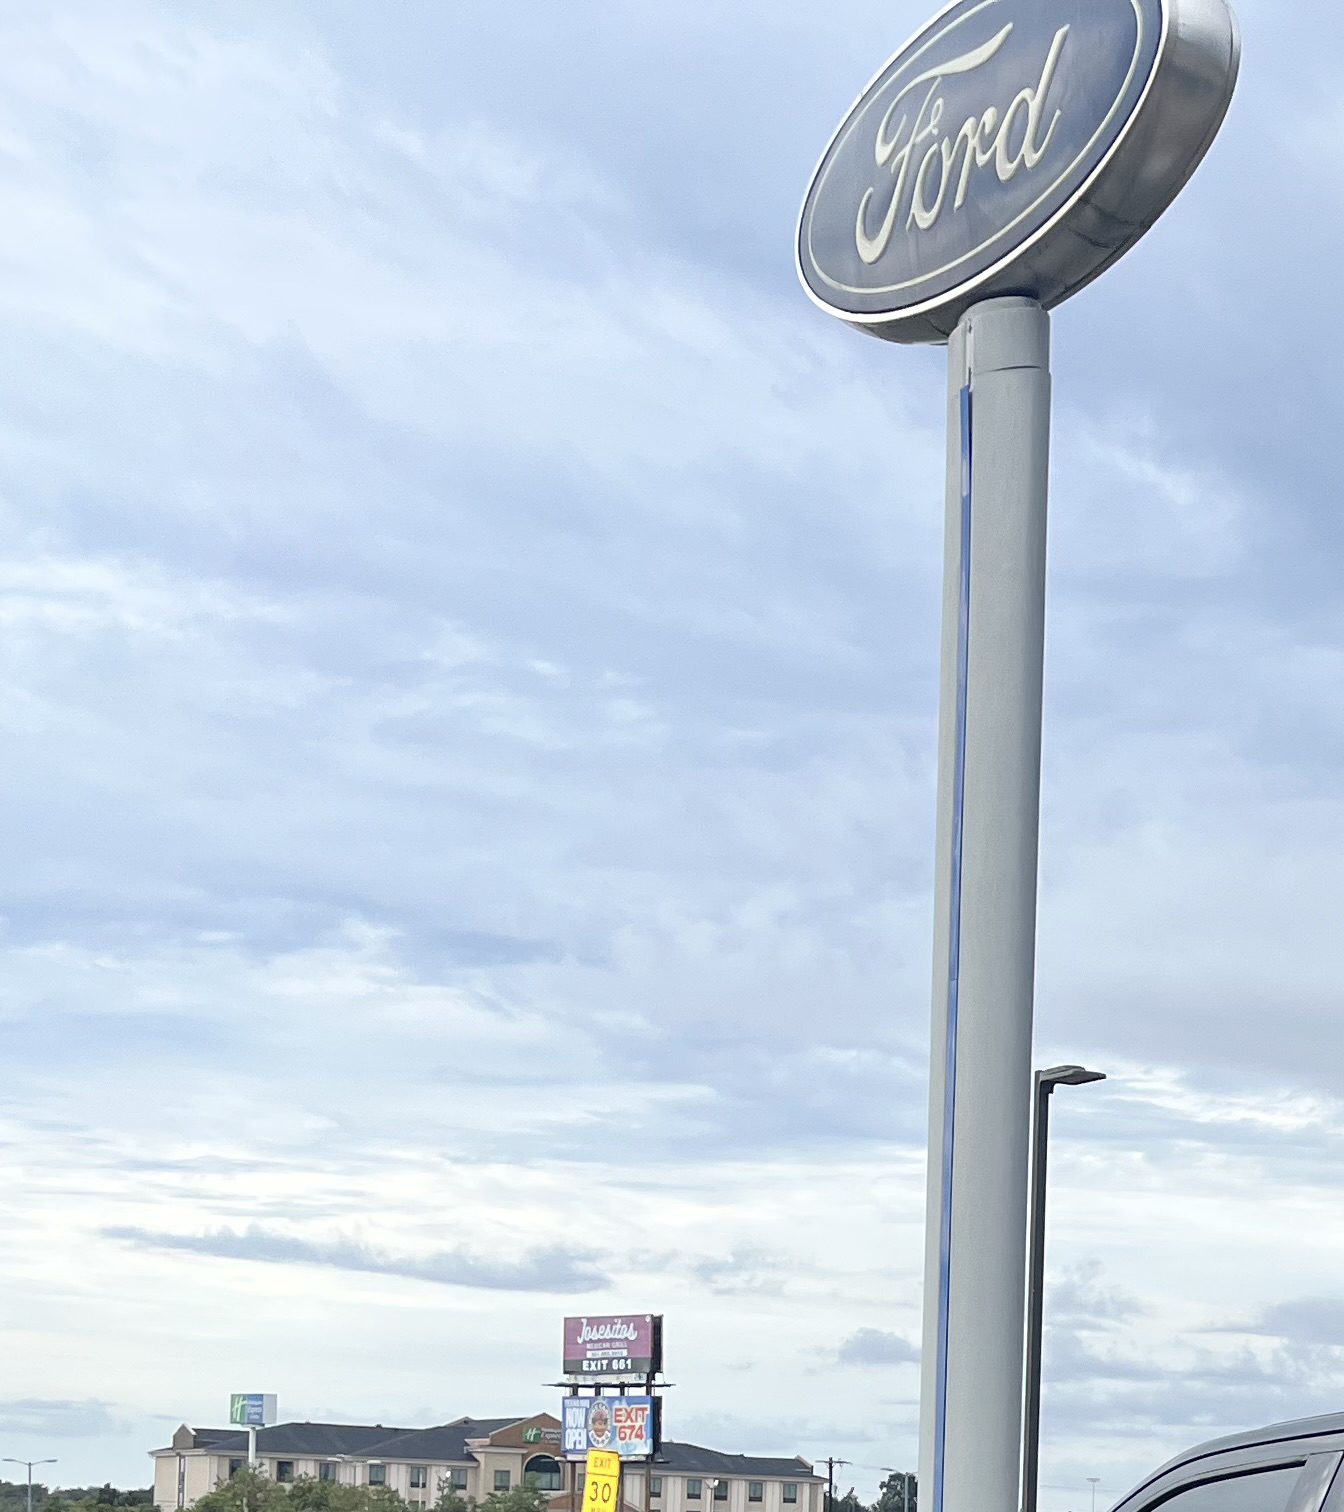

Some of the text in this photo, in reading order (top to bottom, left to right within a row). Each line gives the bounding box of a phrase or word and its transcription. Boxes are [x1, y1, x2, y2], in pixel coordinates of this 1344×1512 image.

[855, 21, 1071, 265] Ford
[577, 1318, 638, 1344] Josesitos
[582, 1359, 632, 1372] EXIT 661
[565, 1407, 586, 1429] NOW
[613, 1406, 649, 1424] EXIT
[565, 1428, 587, 1450] OPEN
[617, 1424, 645, 1442] 674
[593, 1457, 611, 1469] EXIT
[589, 1481, 611, 1503] 30
